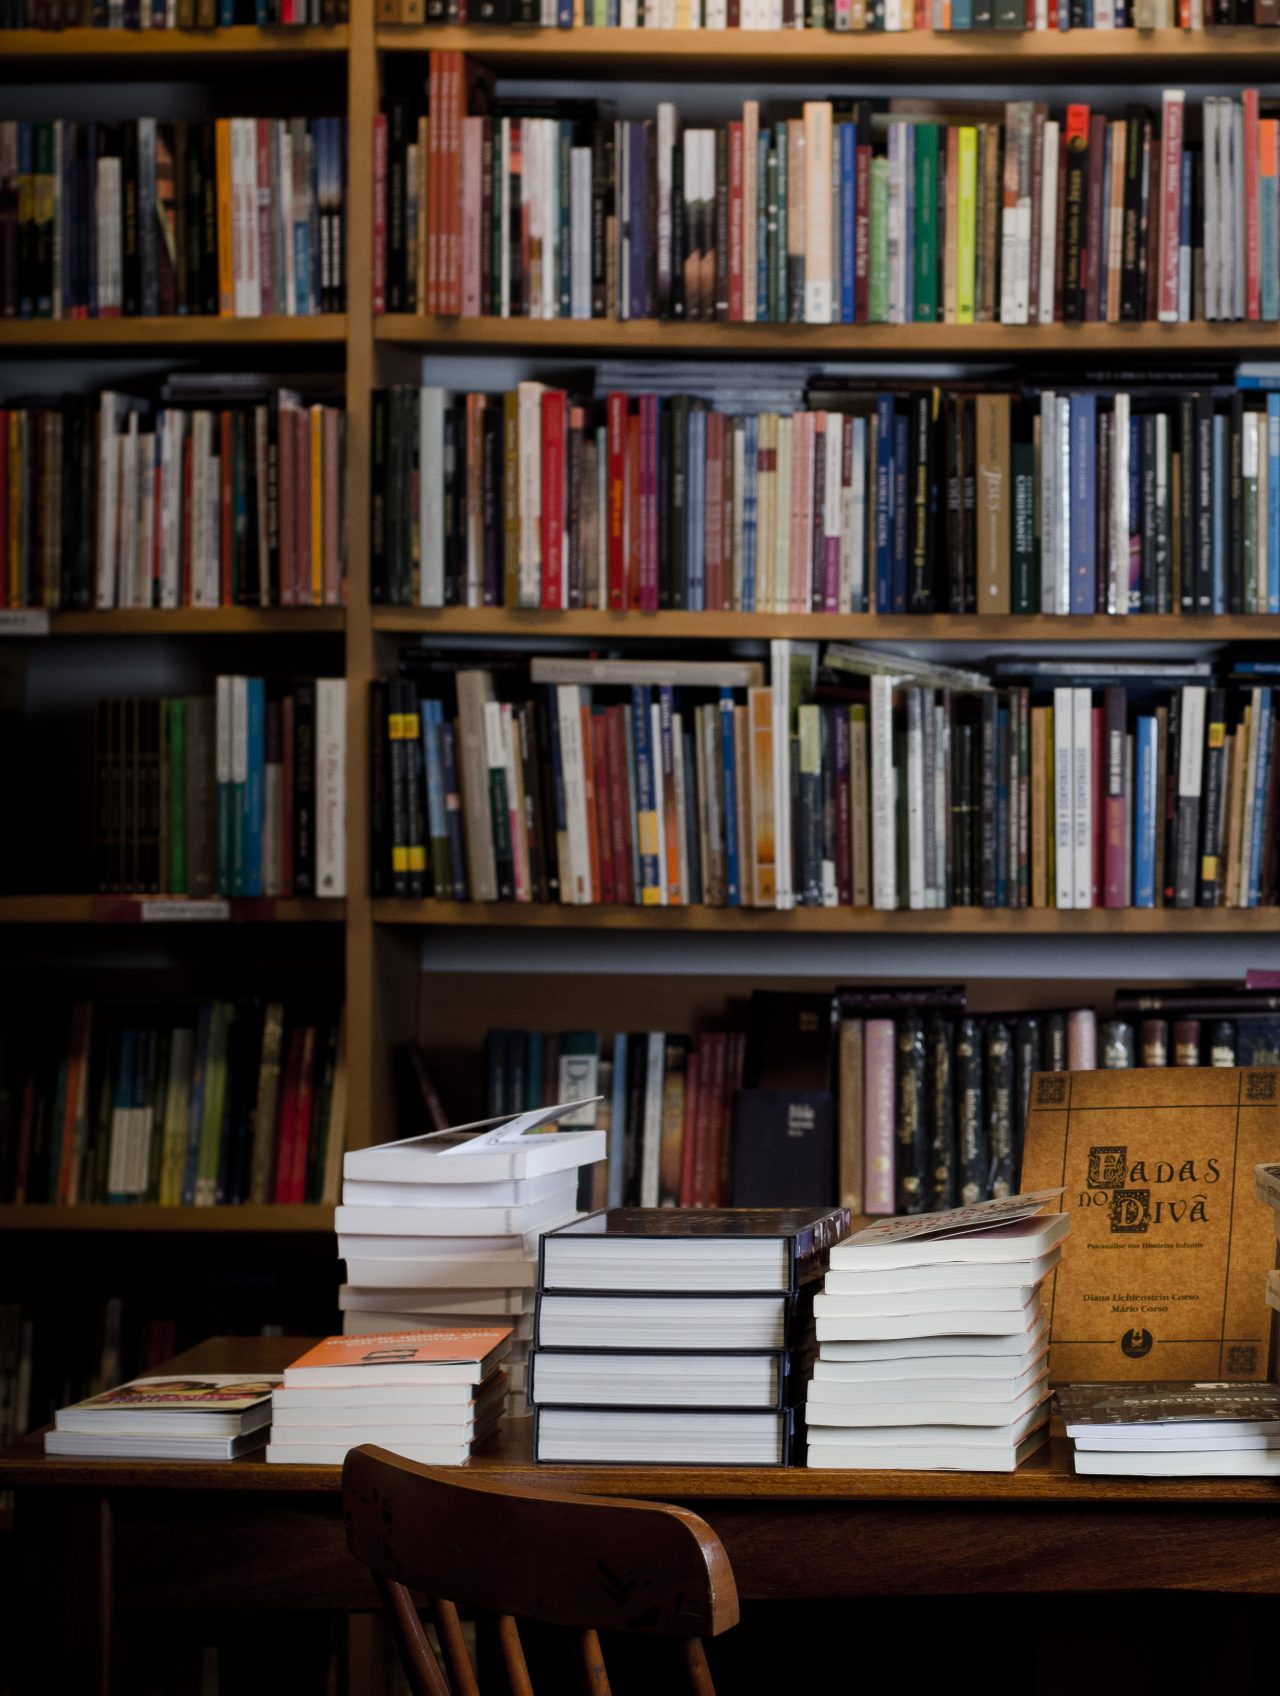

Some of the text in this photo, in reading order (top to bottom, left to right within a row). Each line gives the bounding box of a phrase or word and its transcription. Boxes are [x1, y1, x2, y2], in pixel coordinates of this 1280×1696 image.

[1087, 1146, 1221, 1190] FADAS
[1108, 1189, 1210, 1233] DIVÃ
[1087, 1242, 1126, 1250] Psicanálise
[1083, 1292, 1200, 1302] Diana Lichtenstein Corso
[1110, 1303, 1169, 1313] Mário Corso
[1122, 1396, 1279, 1407] sociologia
